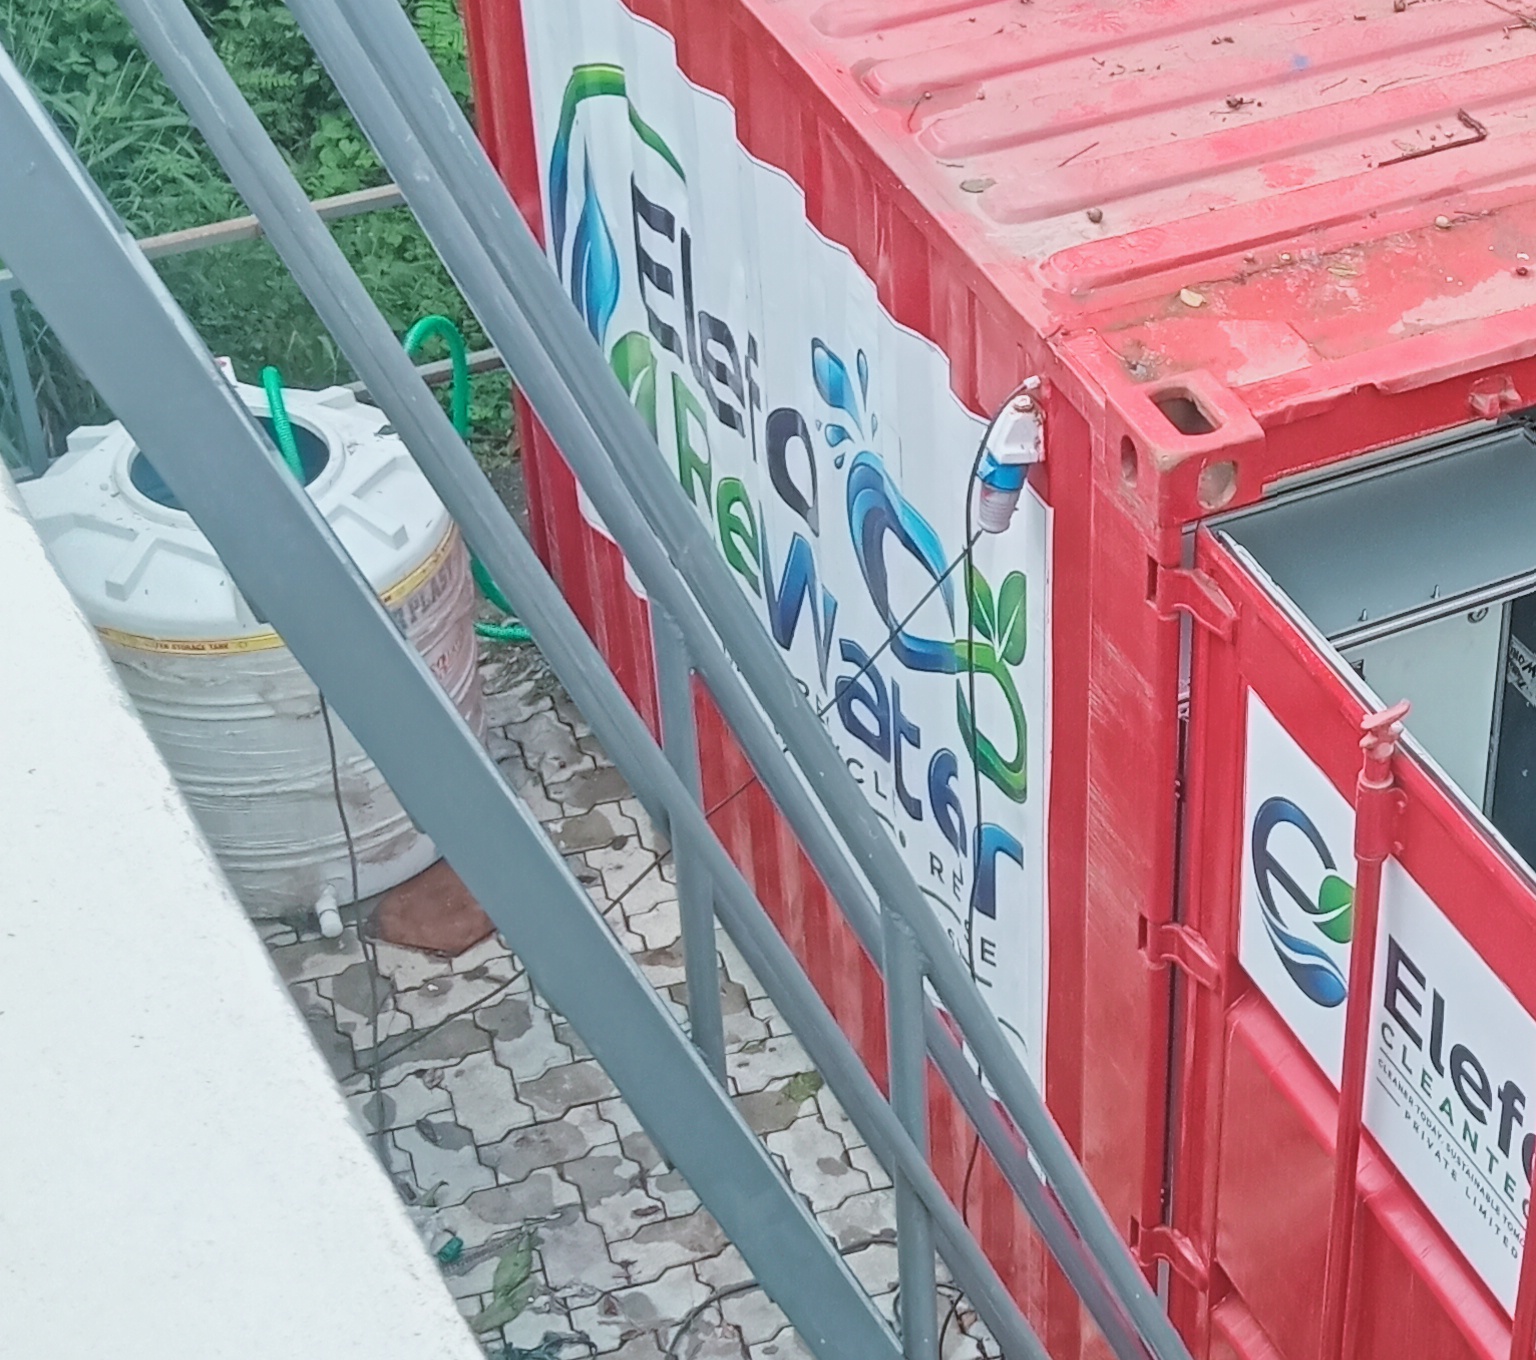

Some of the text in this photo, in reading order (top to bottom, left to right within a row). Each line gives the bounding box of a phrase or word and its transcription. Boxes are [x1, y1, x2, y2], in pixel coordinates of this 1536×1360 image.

[209, 642, 229, 650] TANK
[1377, 1058, 1414, 1107] CLEANER
[1446, 1142, 1501, 1216] SUSTAINABLE
[1404, 1109, 1519, 1260] PRIVATE LIMITED
